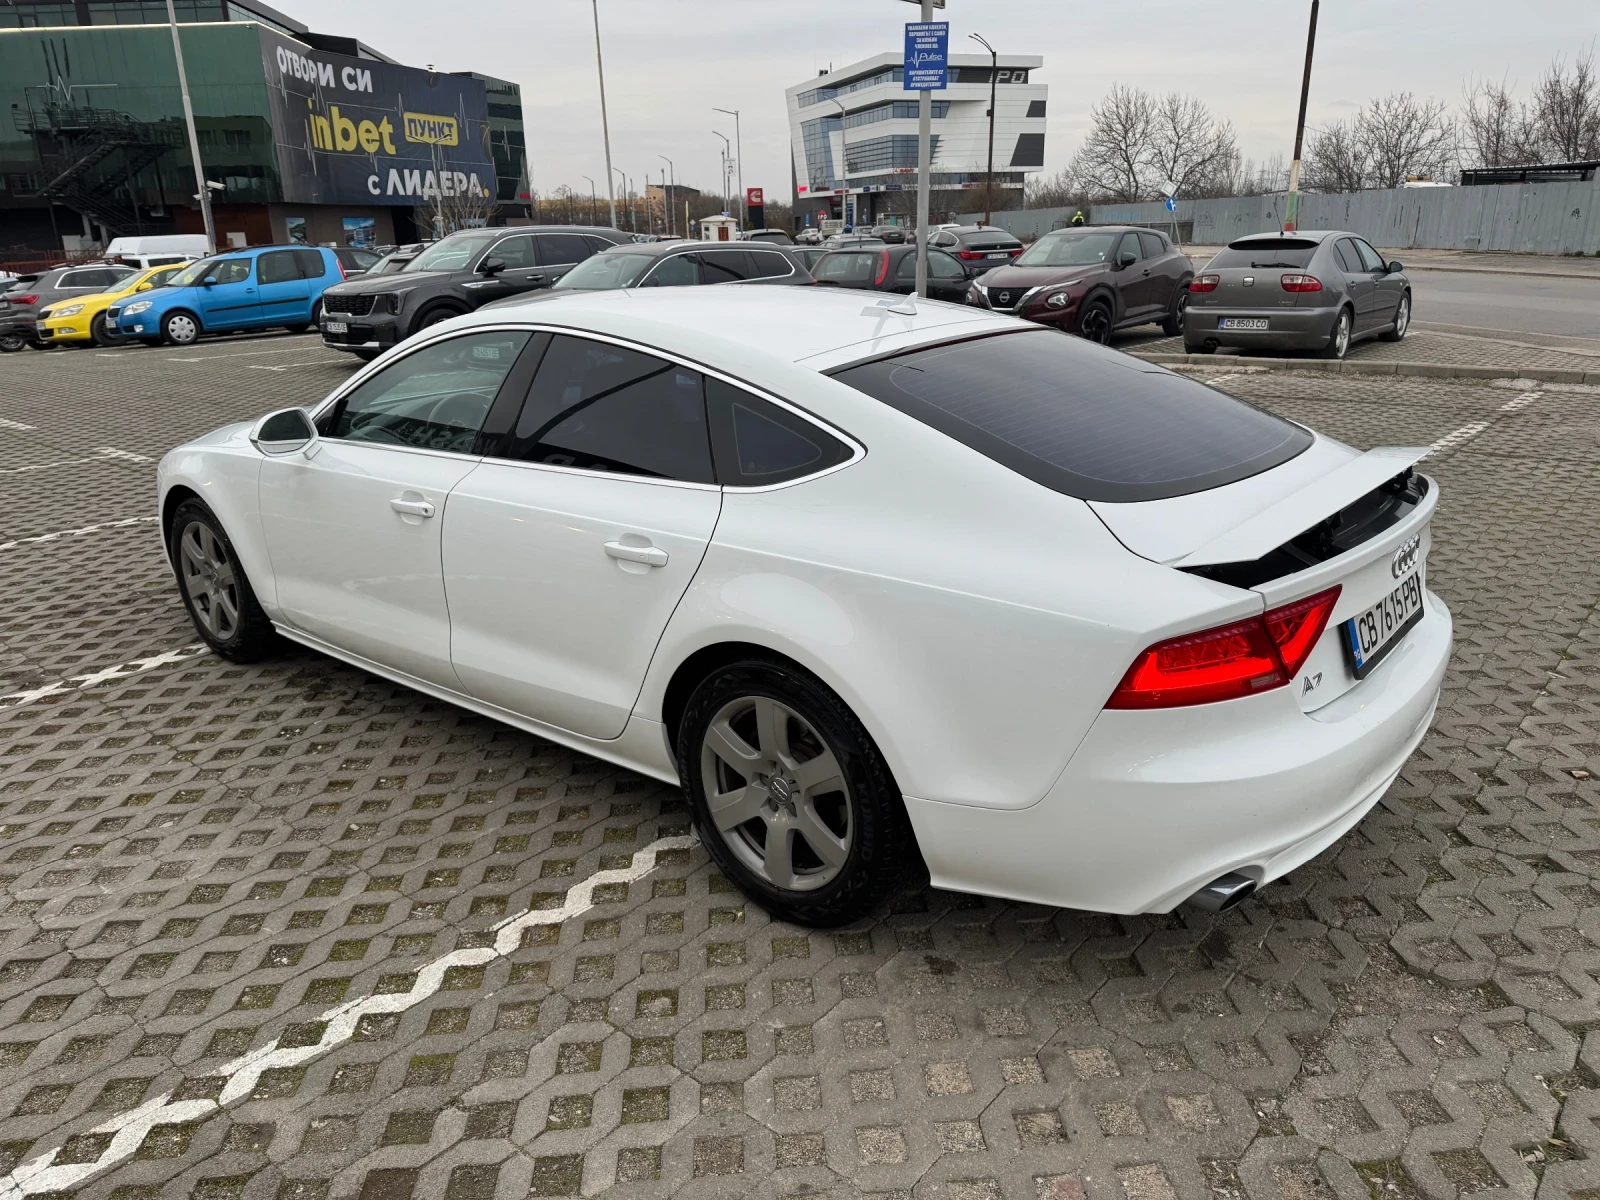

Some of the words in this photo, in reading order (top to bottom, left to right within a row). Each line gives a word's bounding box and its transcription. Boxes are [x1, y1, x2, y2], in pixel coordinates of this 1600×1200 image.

[919, 52, 943, 60] Pulse
[277, 46, 335, 88] ОТВОРИ
[342, 66, 373, 93] СИ
[988, 71, 1026, 83] IPO
[308, 98, 396, 155] inbet
[407, 118, 454, 141] ПУНКТ
[1225, 319, 1235, 328] CB
[1236, 319, 1254, 328] 8503
[1256, 320, 1266, 328] CO
[1358, 610, 1378, 654] CB
[1376, 587, 1404, 639] 7615
[1402, 575, 1418, 614] PB
[1301, 671, 1323, 698] A7
